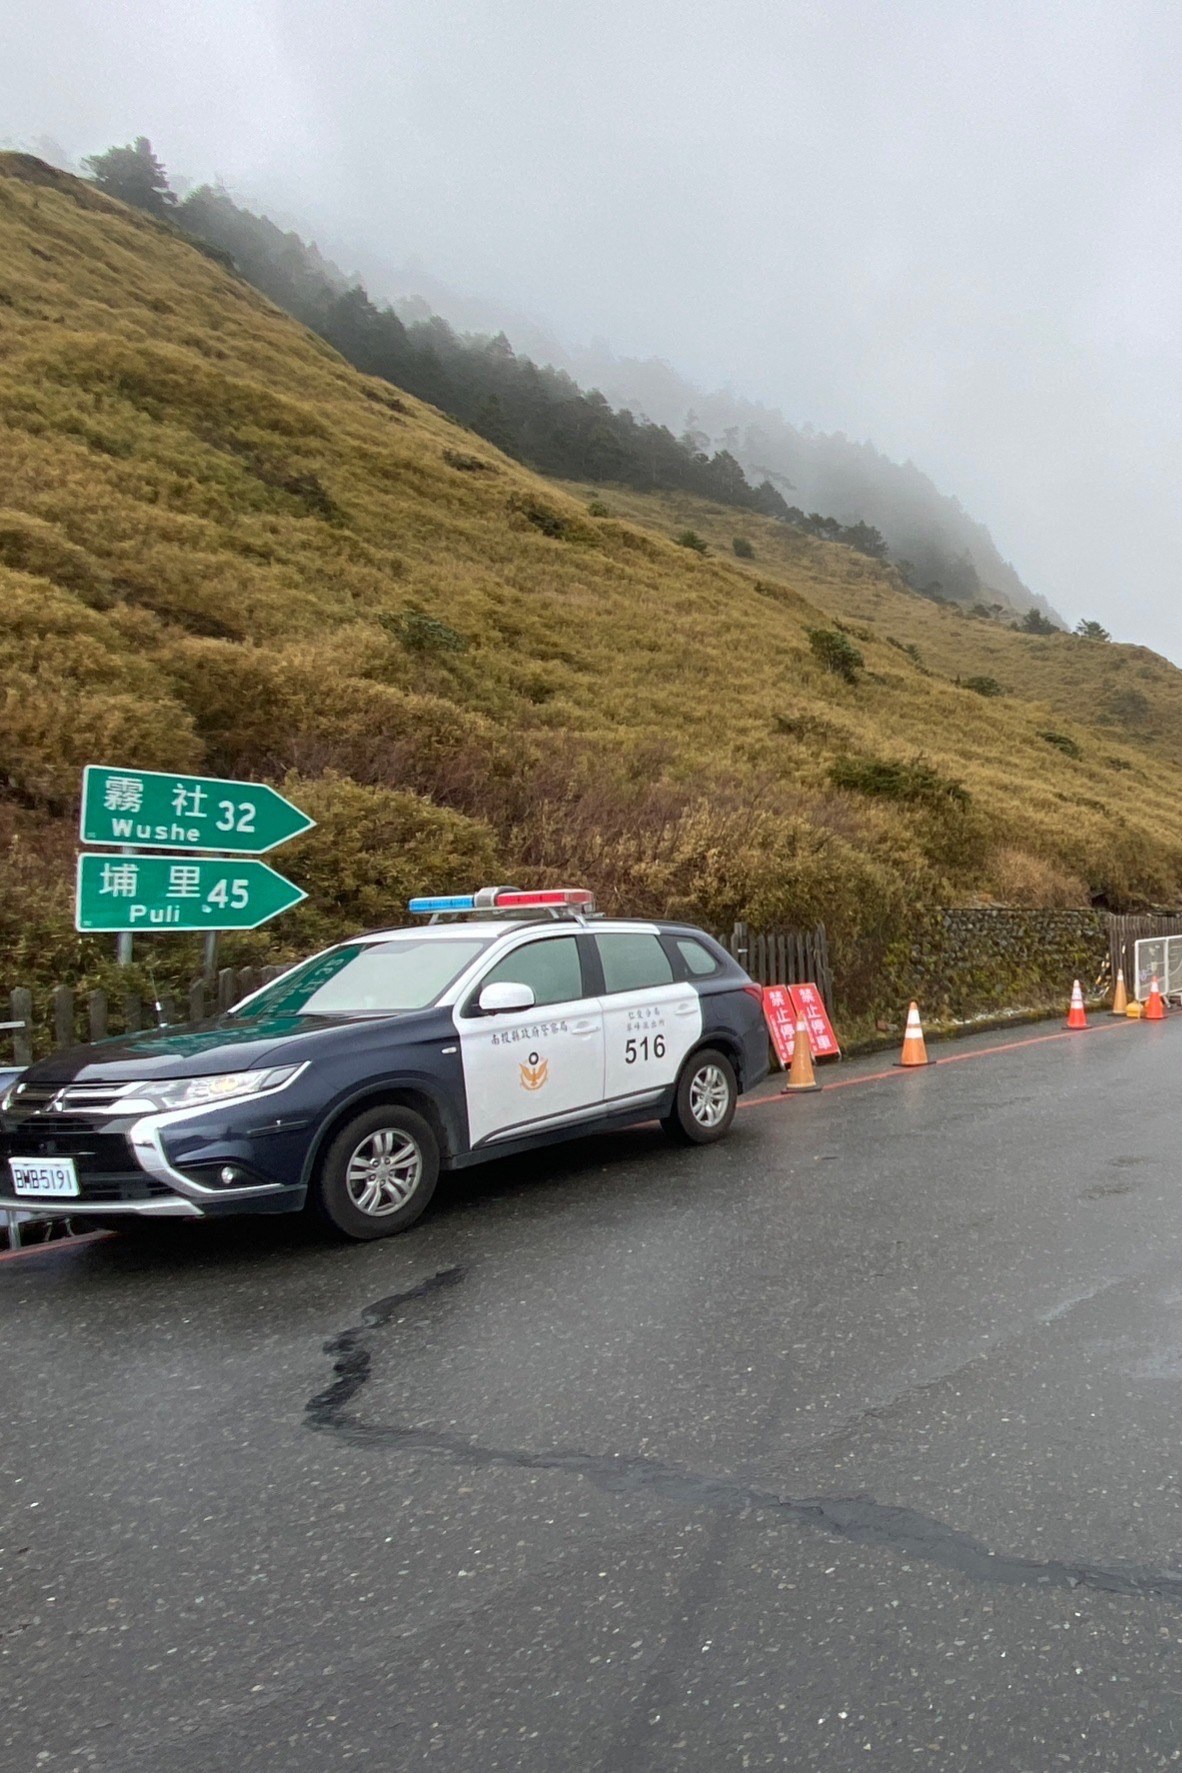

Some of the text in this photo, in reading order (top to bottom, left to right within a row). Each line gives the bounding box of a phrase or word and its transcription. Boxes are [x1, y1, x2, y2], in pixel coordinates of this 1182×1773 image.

[103, 776, 208, 818] 霧社
[111, 818, 200, 842] Wushe
[215, 800, 257, 833] 32
[99, 863, 201, 898] 埔里
[207, 879, 249, 909] 45
[129, 904, 180, 923] Puli
[625, 1034, 665, 1064] 516
